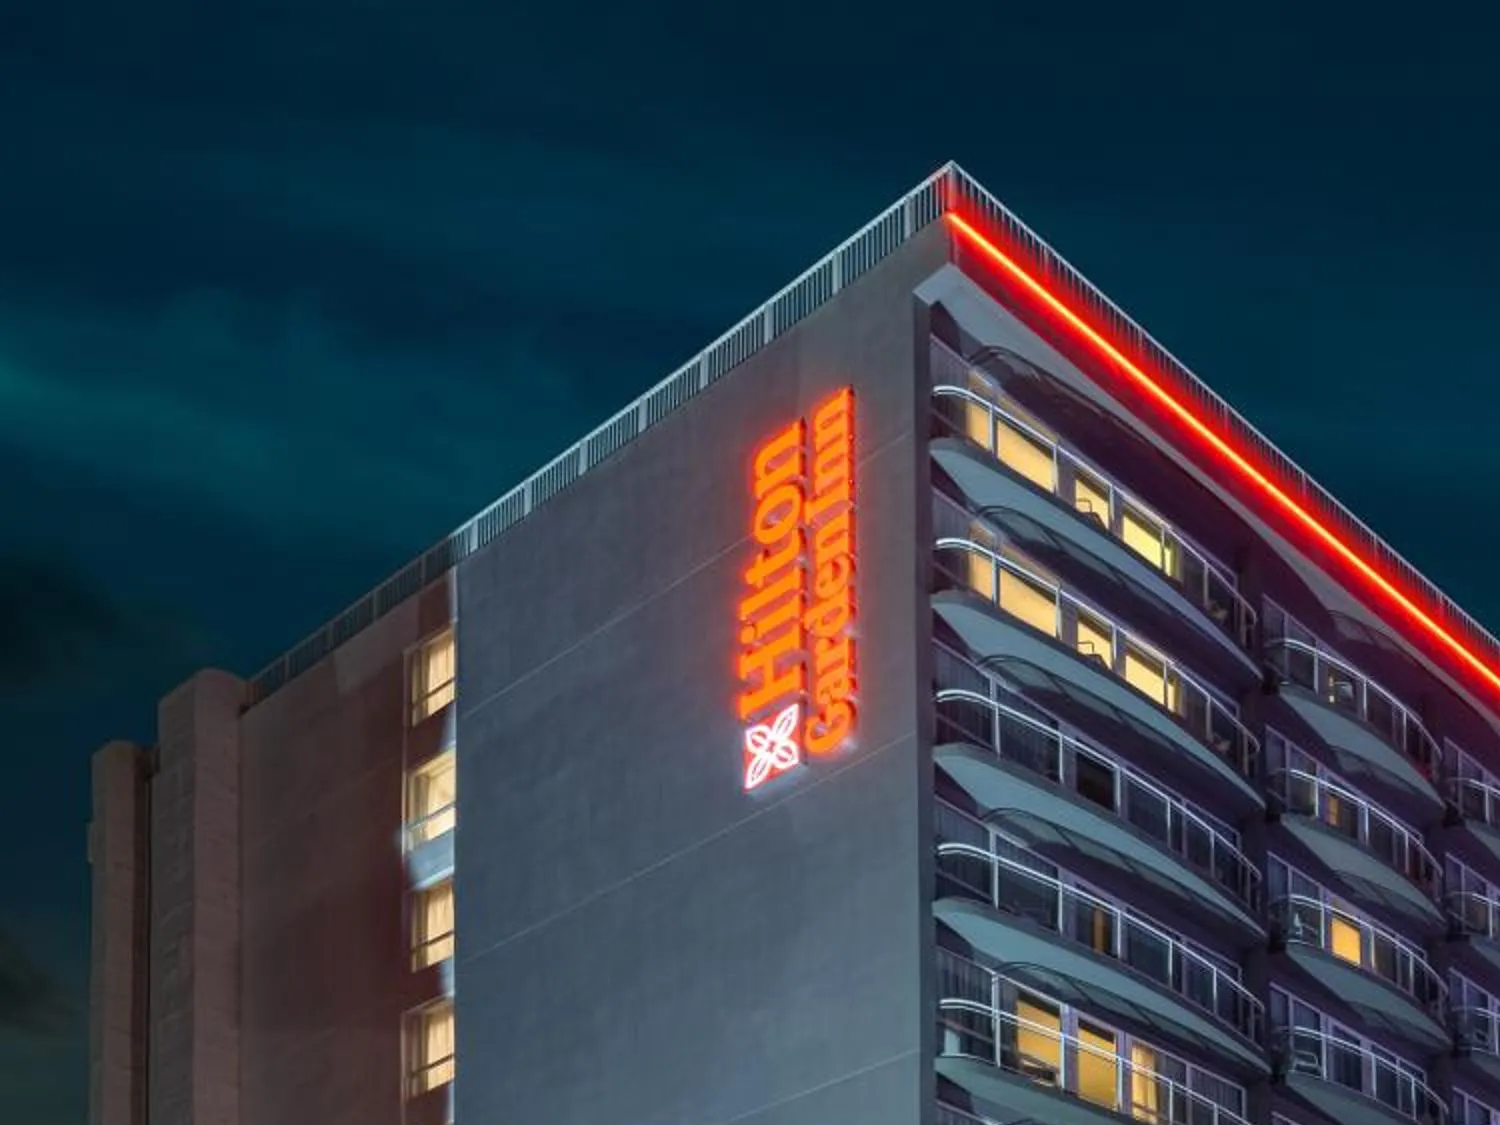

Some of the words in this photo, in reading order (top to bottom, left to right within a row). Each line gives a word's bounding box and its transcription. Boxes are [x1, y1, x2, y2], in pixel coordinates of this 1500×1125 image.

[739, 419, 804, 720] Hilton
[804, 386, 854, 526] Inn
[805, 525, 855, 755] Garden
